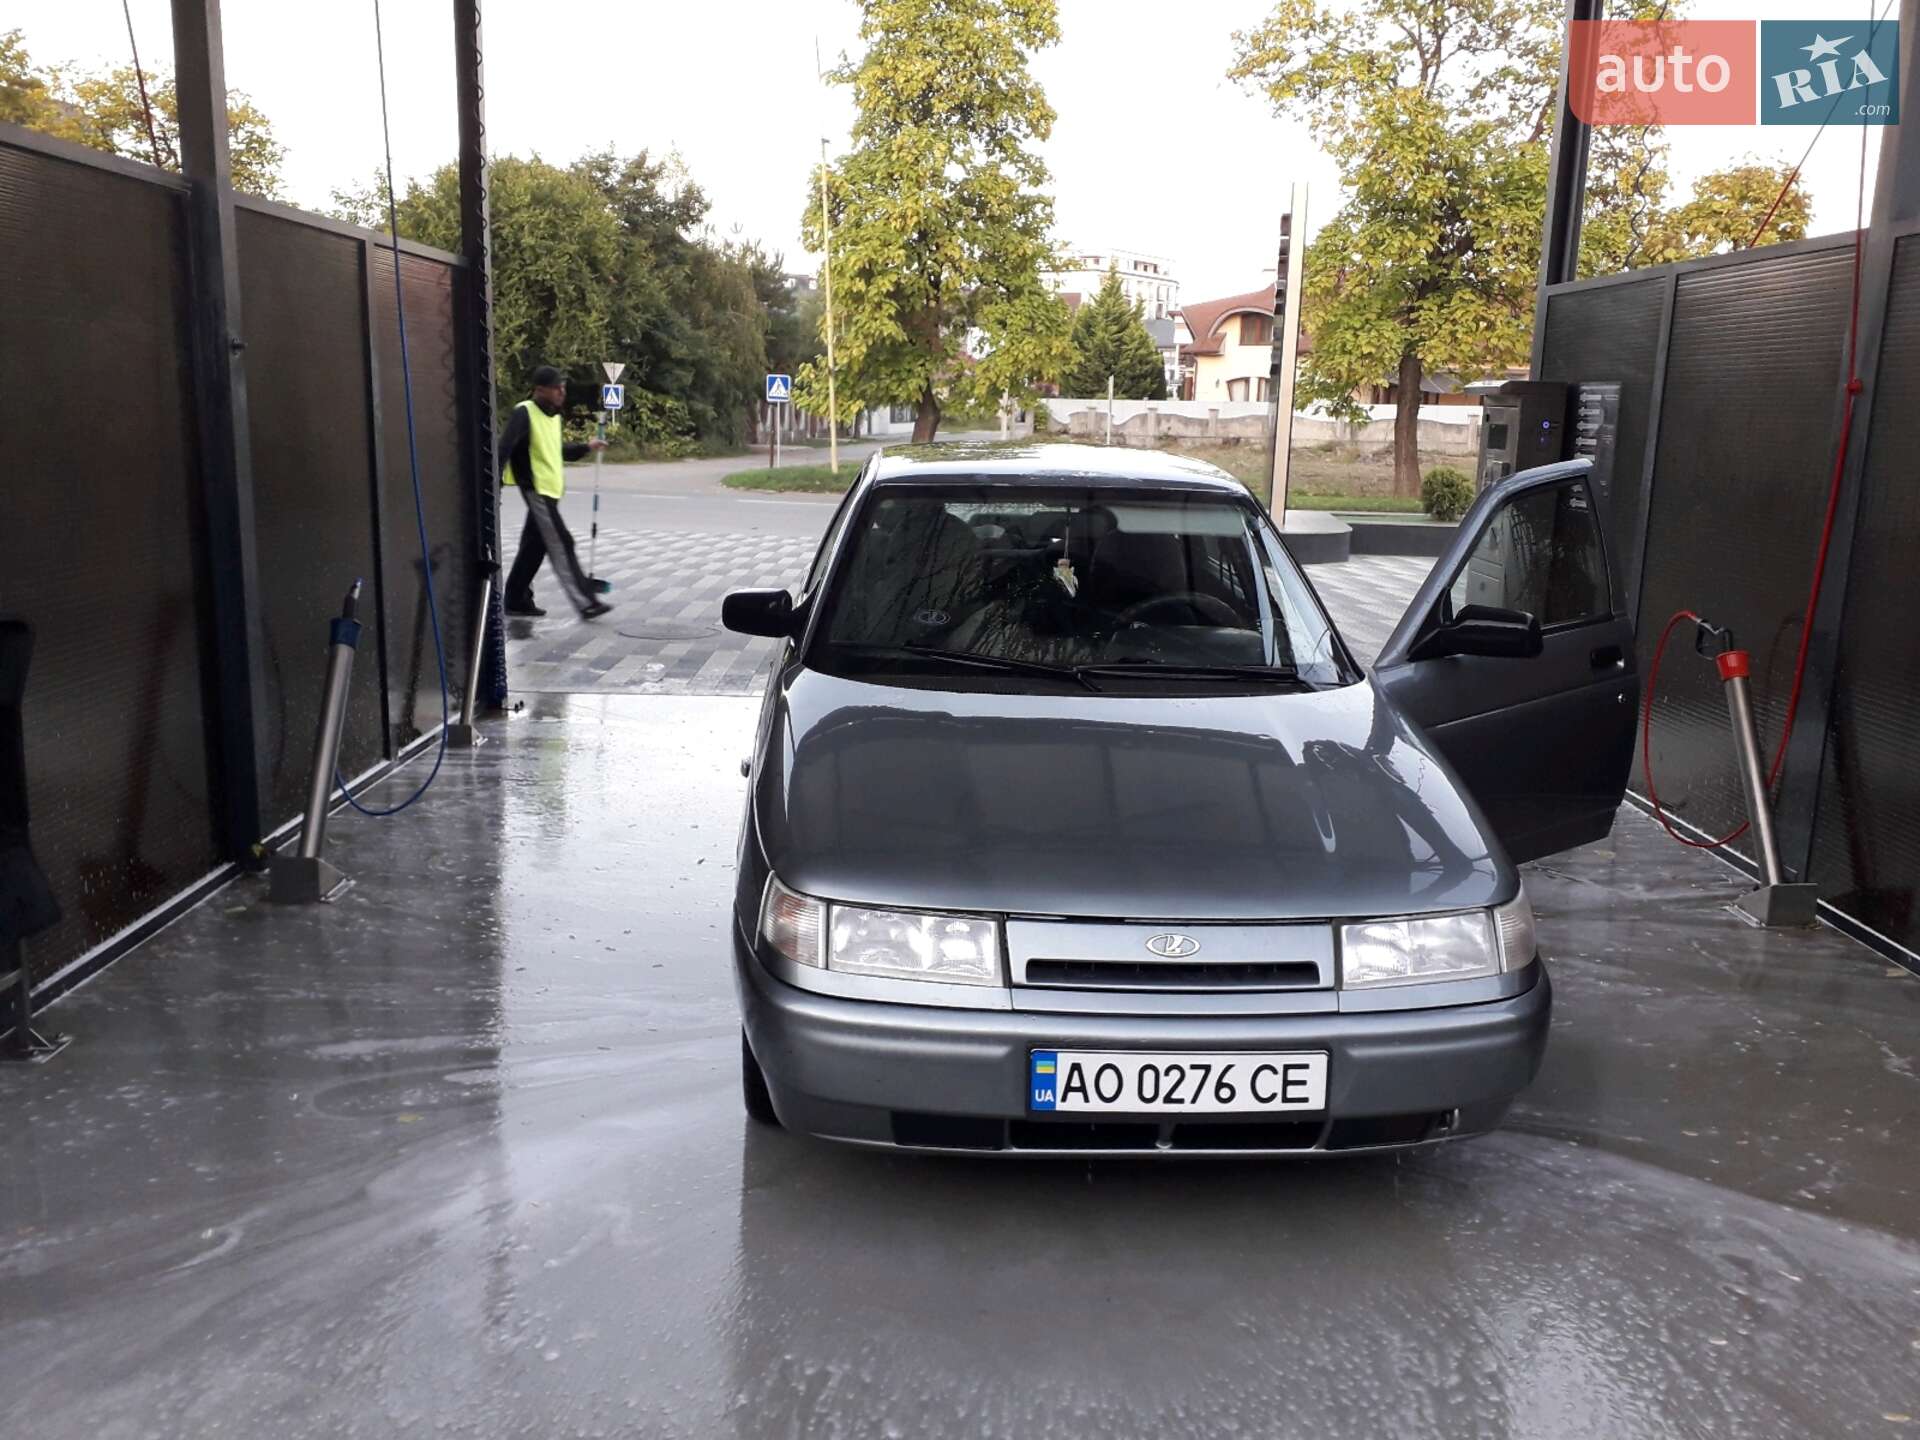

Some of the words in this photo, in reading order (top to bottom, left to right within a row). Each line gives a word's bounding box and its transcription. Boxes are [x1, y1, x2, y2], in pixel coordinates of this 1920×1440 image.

[1035, 1089, 1054, 1102] UA
[1060, 1062, 1124, 1104] AO
[1136, 1063, 1237, 1105] 0276
[1250, 1063, 1310, 1105] CE
